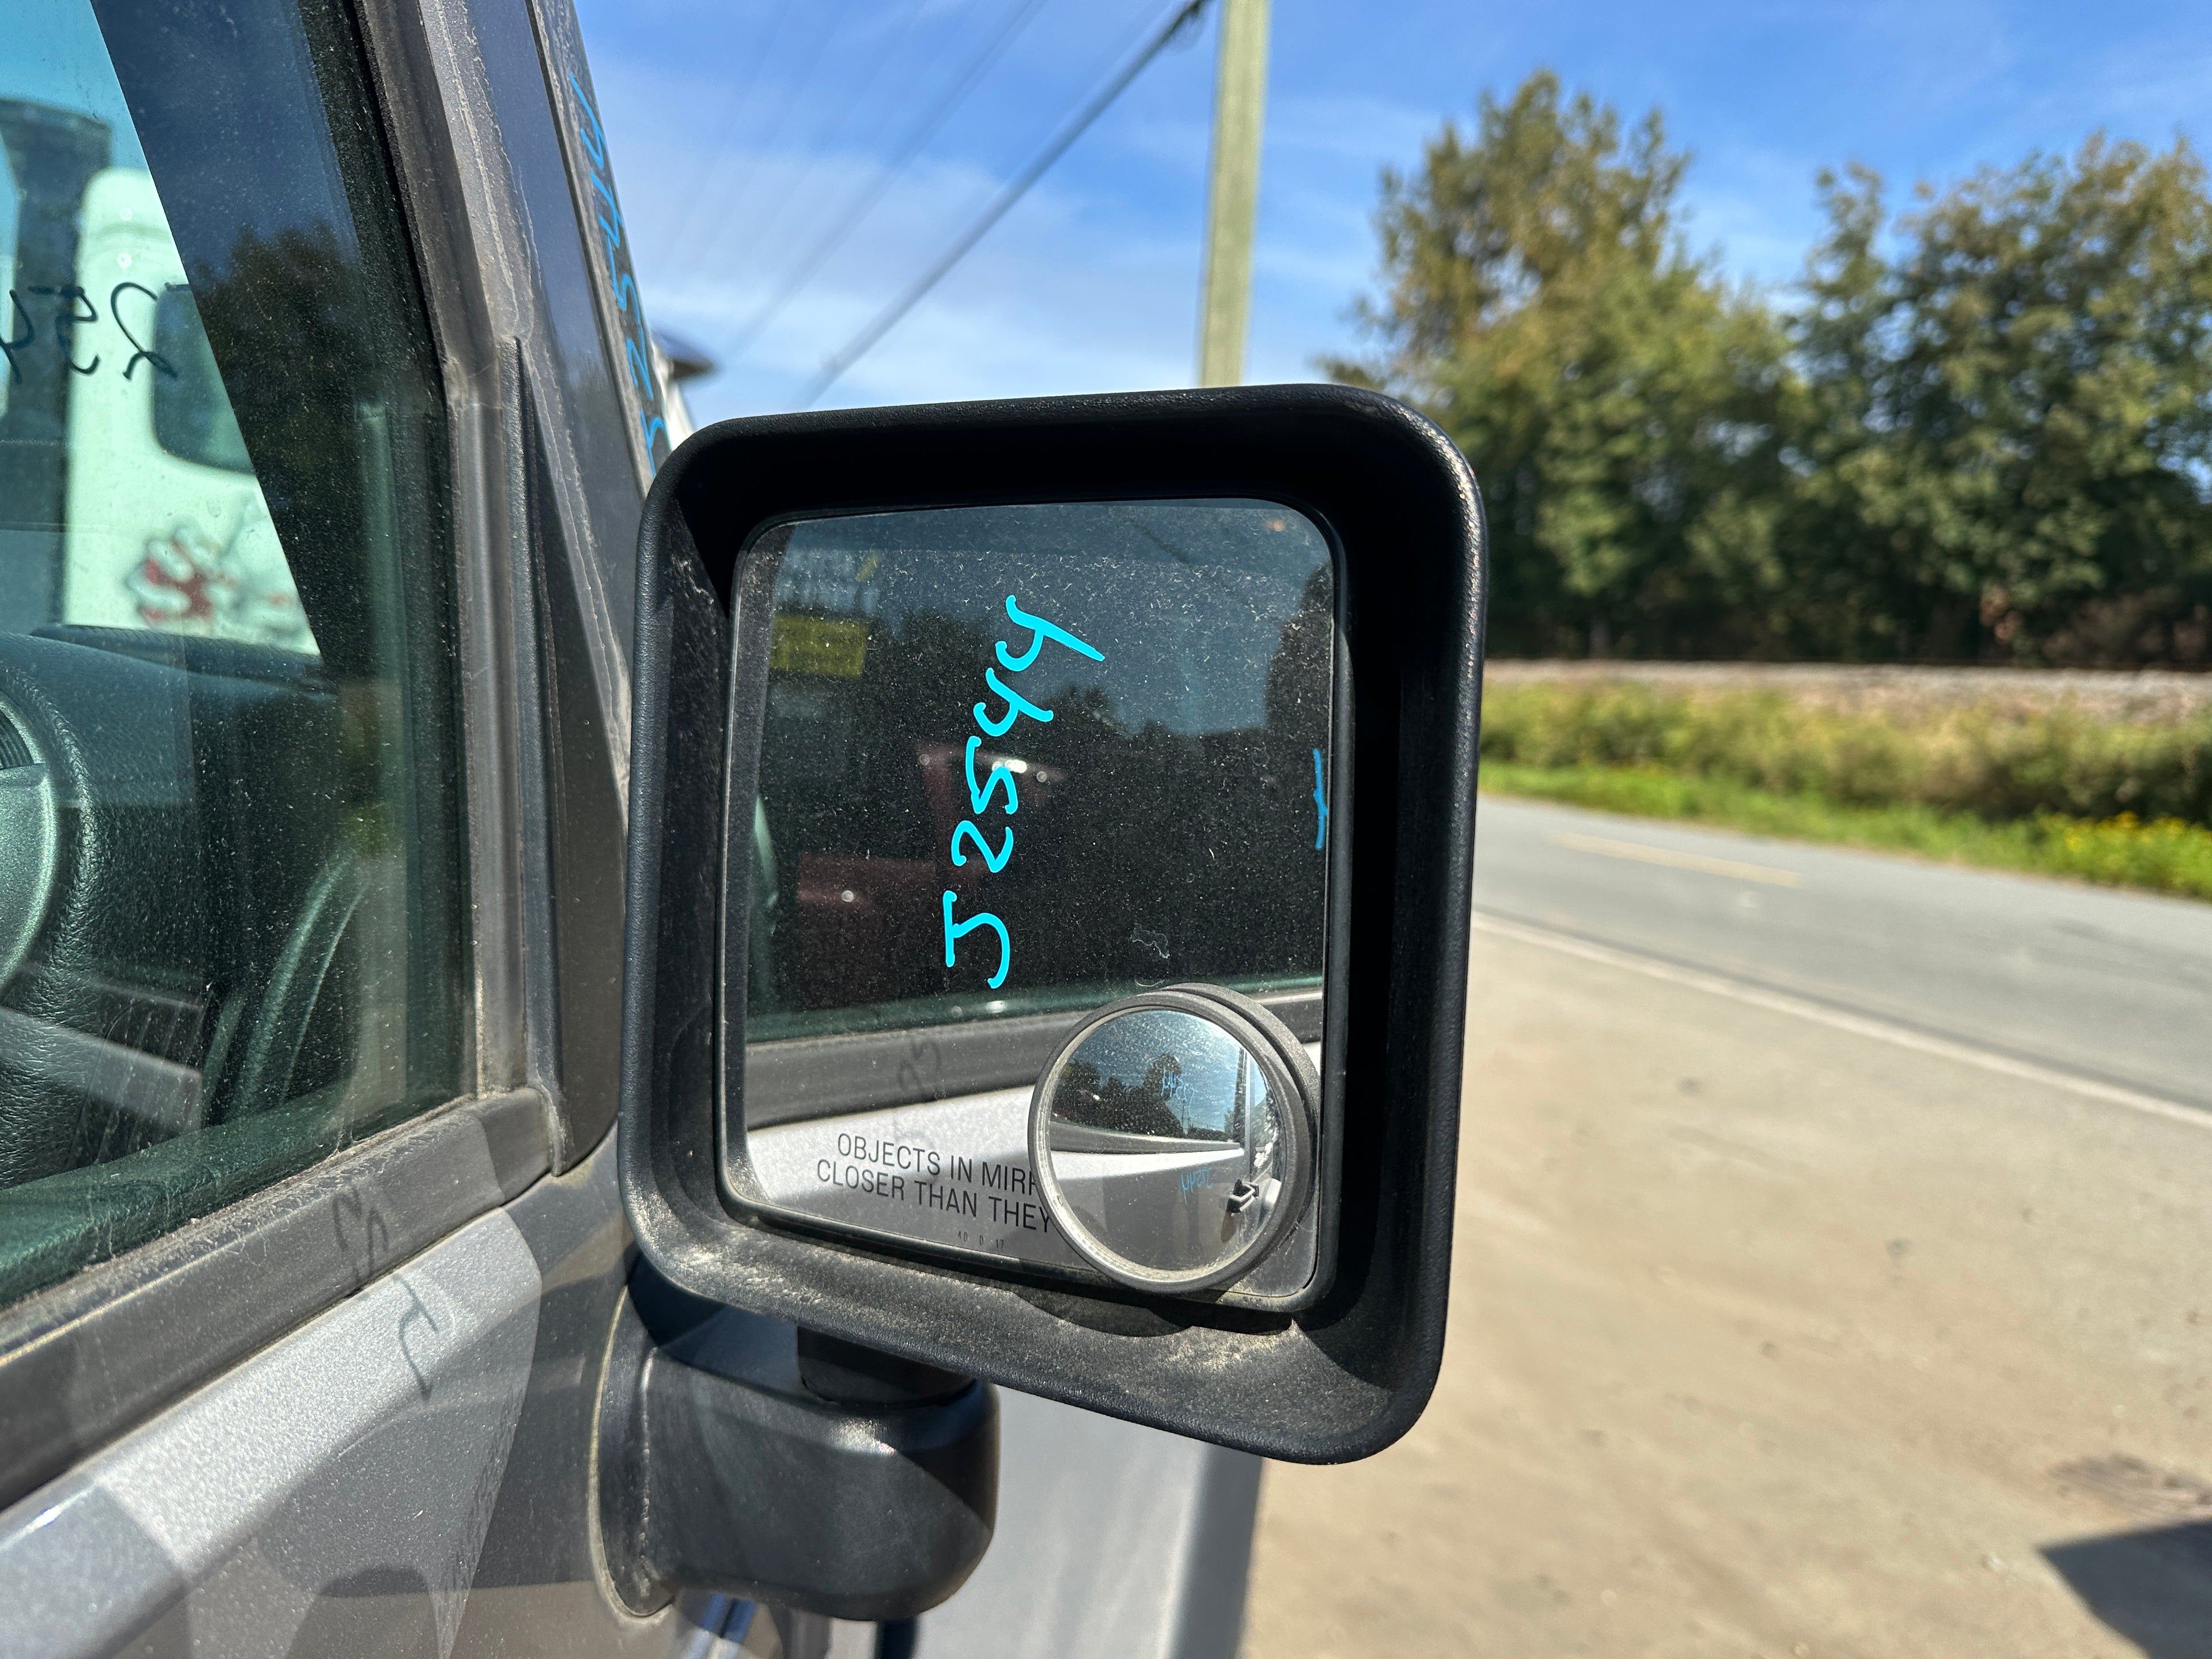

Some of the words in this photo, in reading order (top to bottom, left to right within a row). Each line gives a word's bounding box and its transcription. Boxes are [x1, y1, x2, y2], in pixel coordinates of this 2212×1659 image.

[942, 595, 1105, 988] J2544
[838, 1132, 941, 1176] OBJECTS
[950, 1154, 973, 1183] IN
[817, 1158, 905, 1201] CLOSER
[914, 1180, 978, 1217] THAN
[988, 1195, 1050, 1233] THEY
